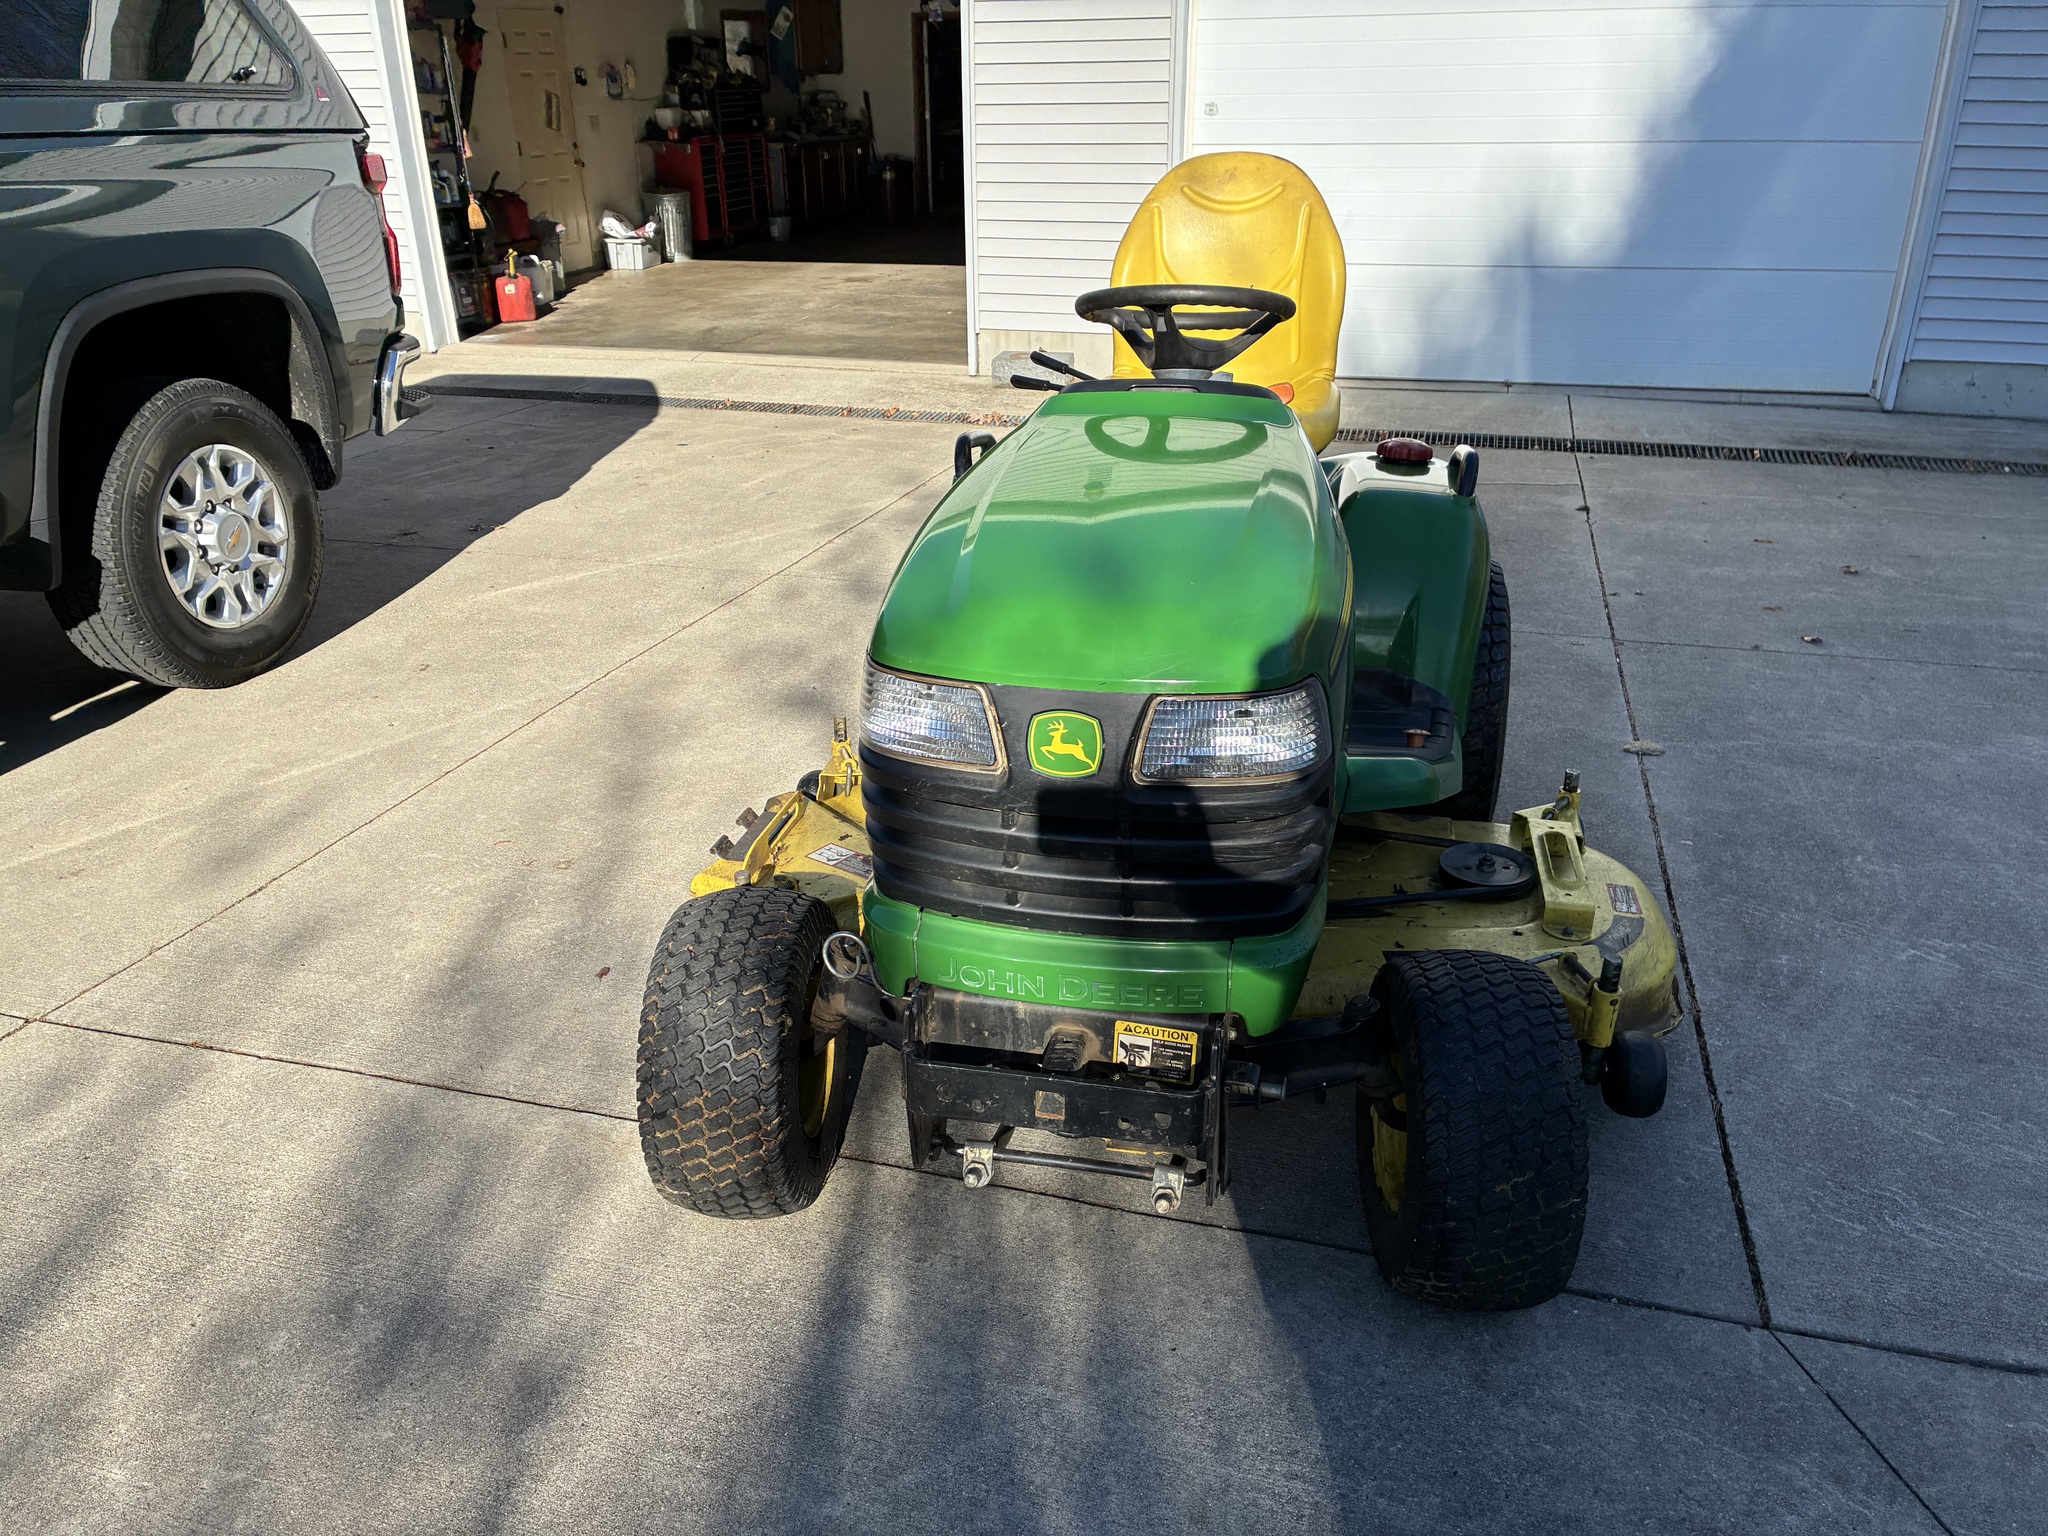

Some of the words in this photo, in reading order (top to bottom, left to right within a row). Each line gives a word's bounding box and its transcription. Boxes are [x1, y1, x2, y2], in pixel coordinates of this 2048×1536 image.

[938, 957, 1044, 998] JOHN
[1058, 974, 1203, 1007] DEERE
[1133, 1025, 1189, 1042] CAUTION
